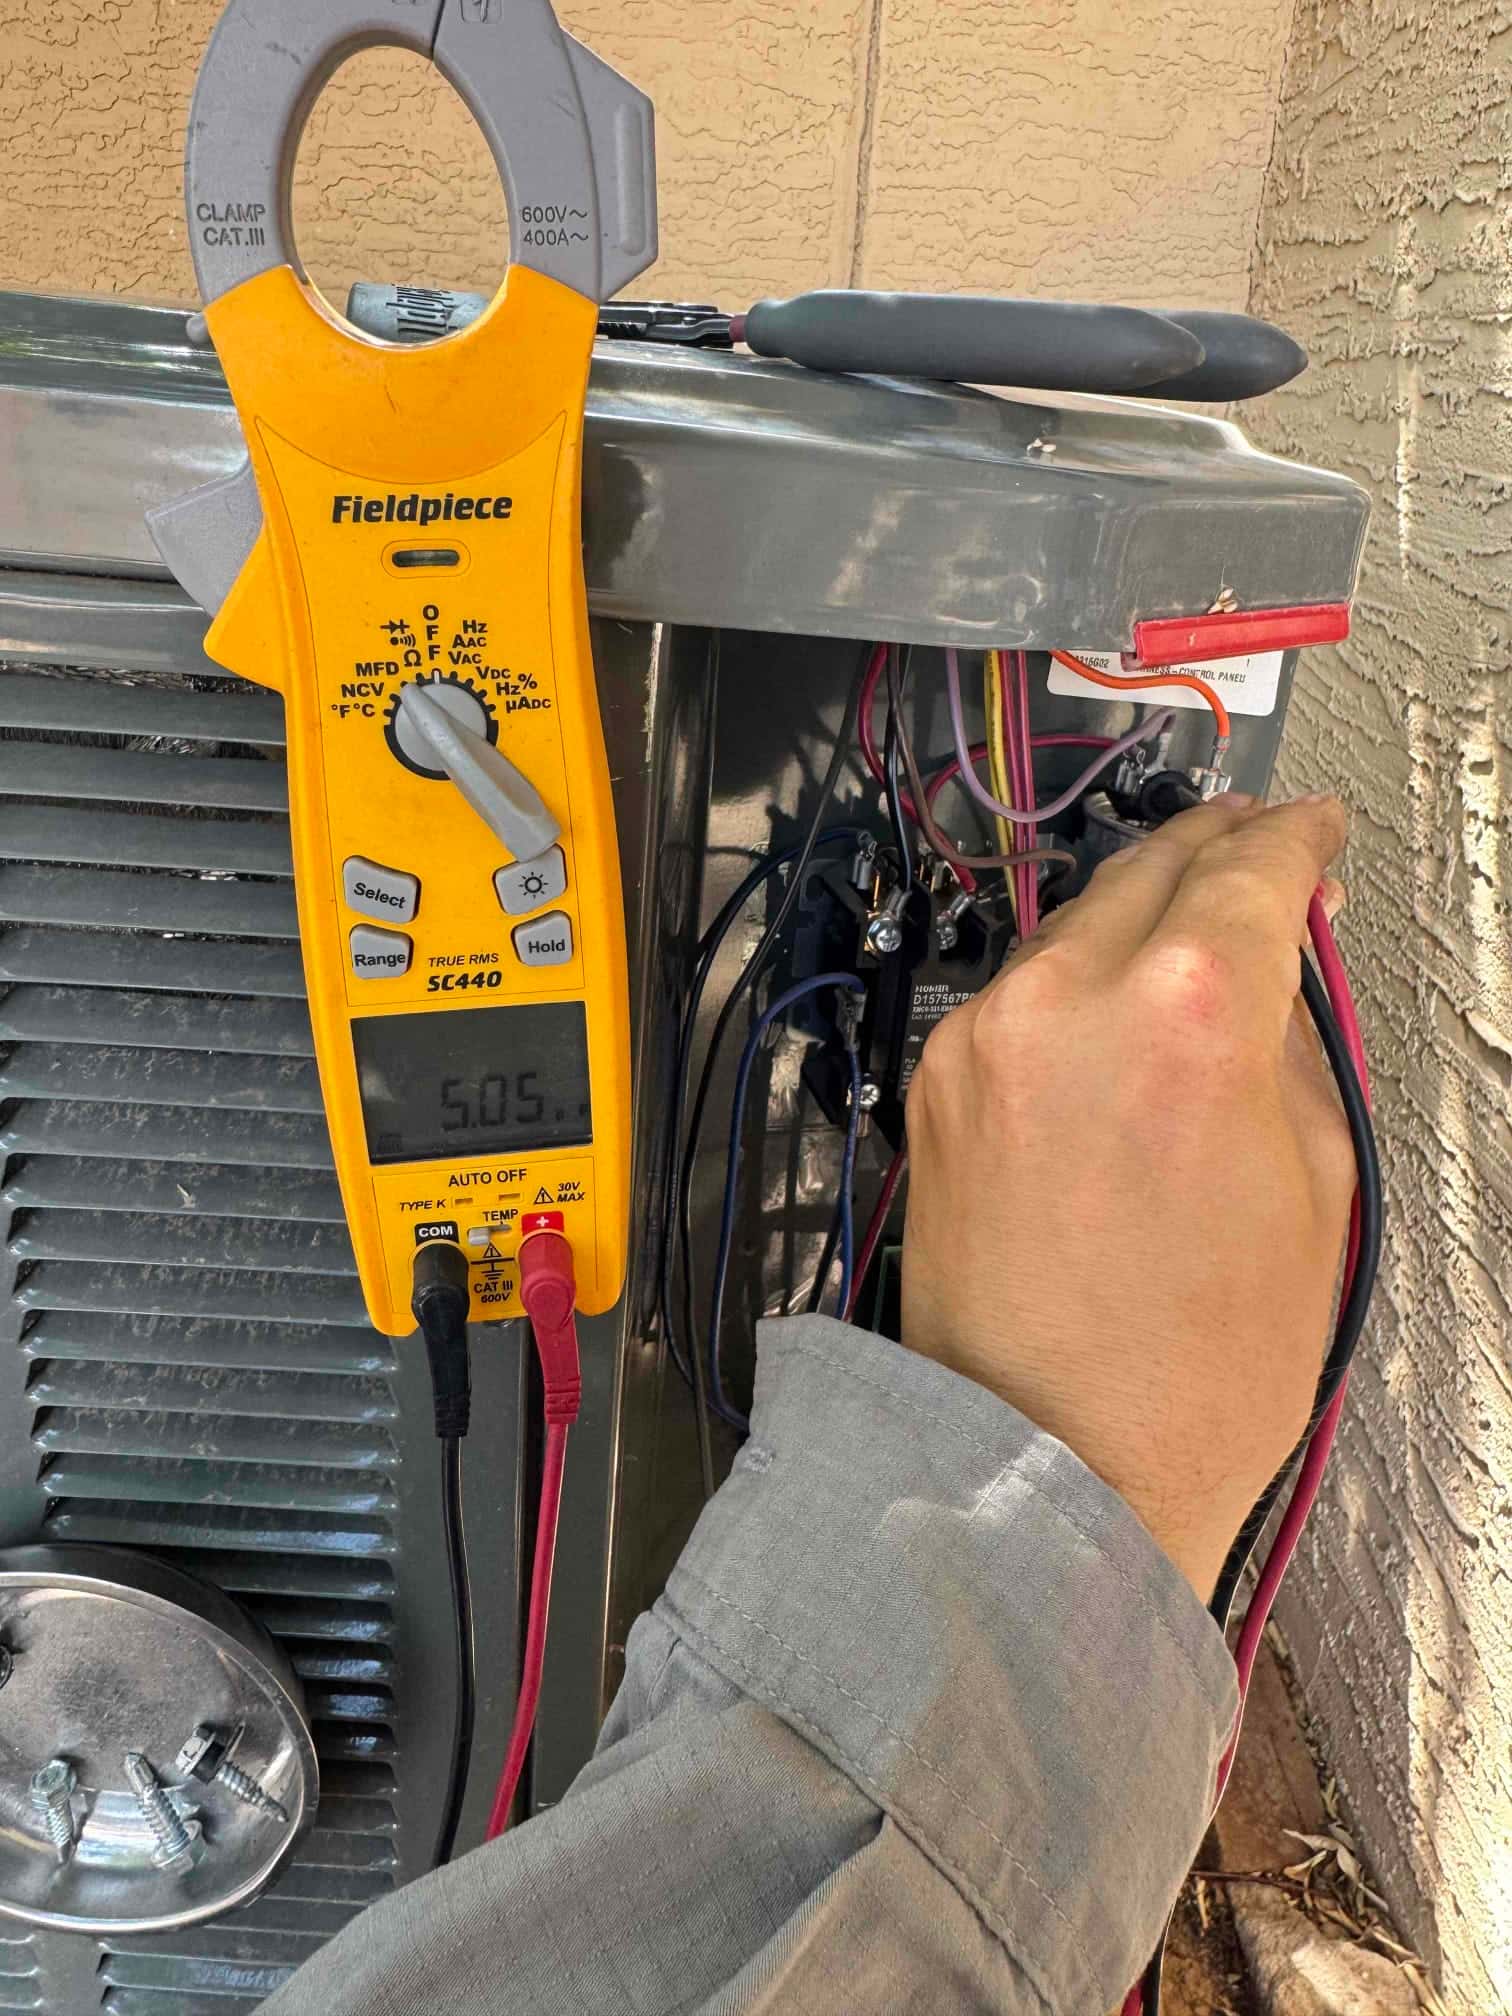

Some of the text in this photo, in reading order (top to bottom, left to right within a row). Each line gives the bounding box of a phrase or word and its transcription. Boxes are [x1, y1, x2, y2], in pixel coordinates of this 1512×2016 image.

[196, 203, 266, 222] CLAMP
[203, 227, 265, 246] CAT.III
[332, 493, 513, 526] Fieldpiece
[462, 619, 488, 634] Hz
[355, 661, 400, 677] MFD
[341, 682, 385, 698] NCV
[352, 881, 406, 909] Select
[527, 938, 566, 954] Hold
[354, 952, 406, 968] Range
[427, 953, 499, 968] TRUE RMS
[427, 970, 503, 993] SC440
[448, 1168, 527, 1188] AUTO OFF
[557, 1182, 581, 1192] 30V
[557, 1192, 586, 1202] MAX
[400, 1198, 447, 1213] TYPE K
[482, 1208, 519, 1222] TEMP
[418, 1224, 454, 1238] COM
[473, 1281, 499, 1295] CAT
[480, 1291, 511, 1304] 600V
